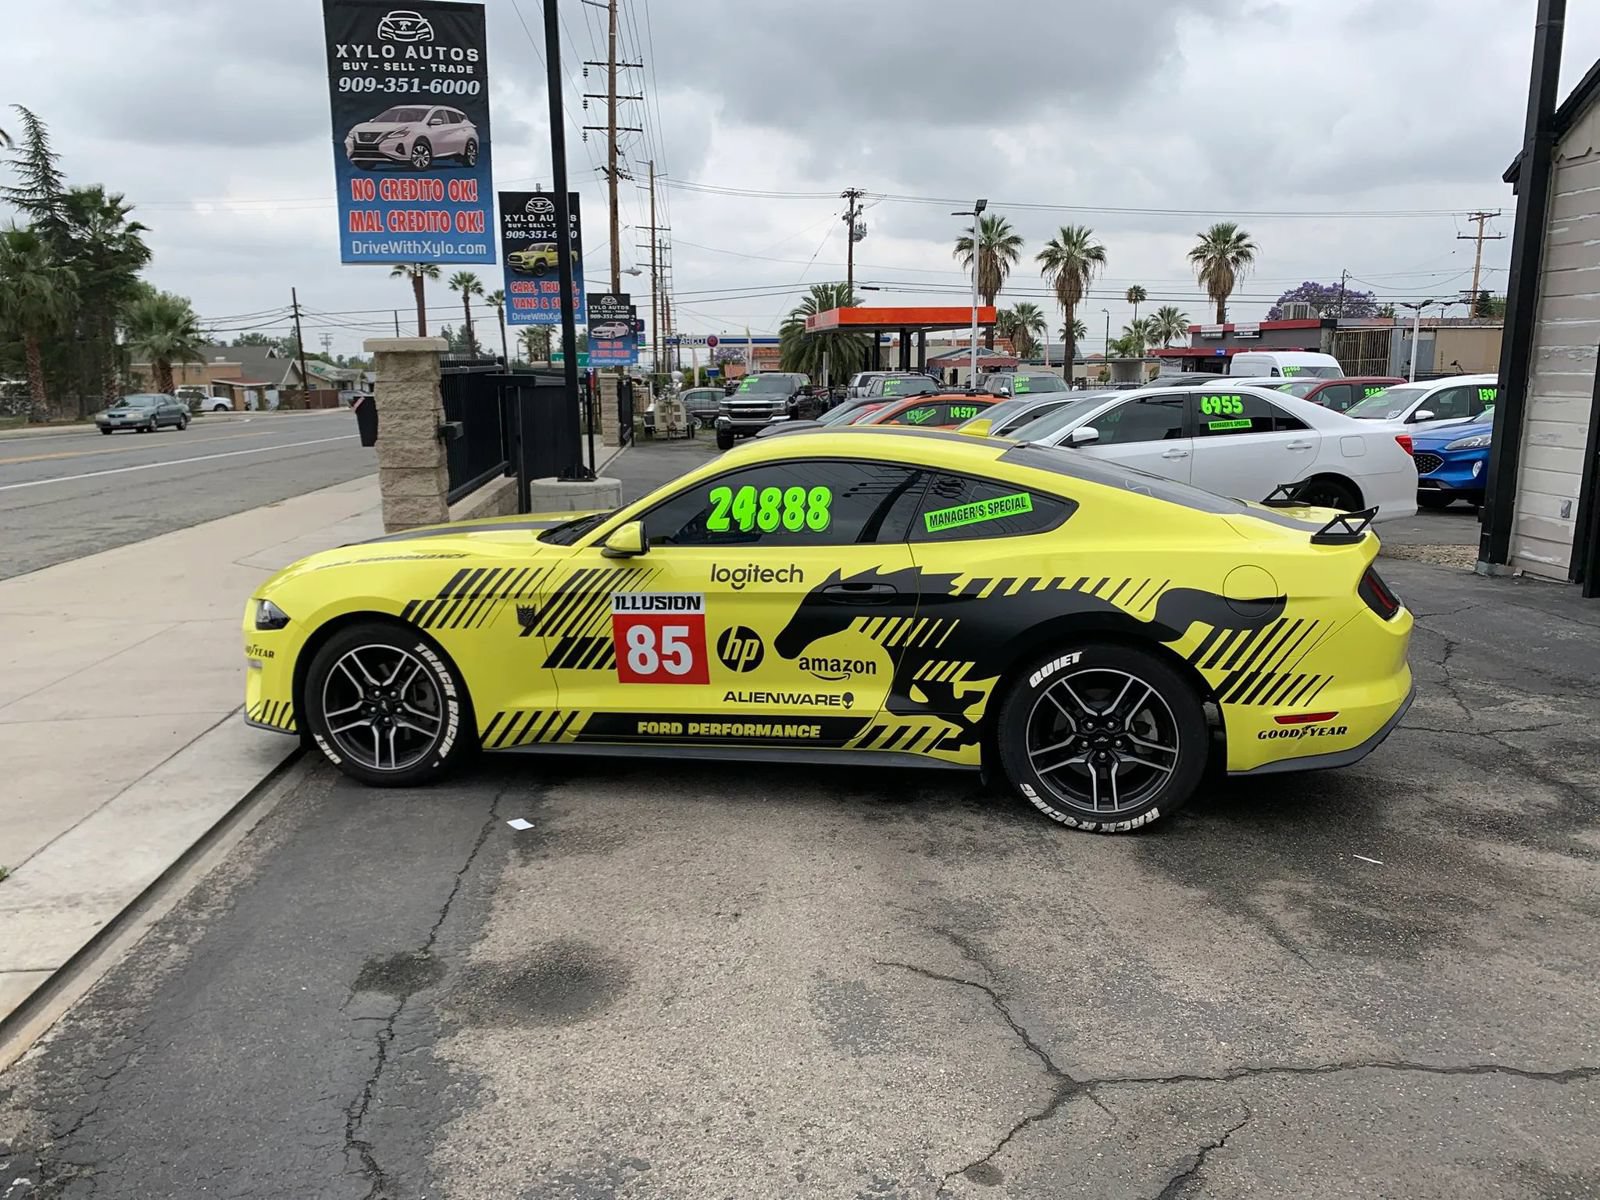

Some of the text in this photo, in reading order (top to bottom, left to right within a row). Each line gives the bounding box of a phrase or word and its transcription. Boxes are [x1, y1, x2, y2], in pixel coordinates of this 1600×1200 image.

[335, 44, 479, 62] XYLO AUTOS
[342, 62, 369, 71] BUY
[383, 62, 415, 72] SELL
[430, 63, 474, 74] TRADE
[338, 77, 480, 95] 909-351-6000
[351, 178, 478, 202] NO CREDITO OK!
[349, 210, 485, 233] MAL CREDITO OK!
[504, 214, 577, 222] XYLO AUS
[506, 230, 578, 239] 909-351-60
[352, 240, 487, 257] DriveWithXylo.com
[511, 281, 539, 295] CARS,
[513, 297, 539, 309] VANS
[541, 297, 549, 309] &
[950, 406, 978, 419] 14577
[1200, 395, 1244, 415] 6955
[706, 486, 832, 532] 24888
[928, 496, 1027, 528] MANAGER'S SPECIAL
[710, 563, 804, 590] logitech
[614, 595, 701, 611] ILLUSION
[625, 624, 694, 676] 85
[722, 626, 759, 672] hp
[414, 642, 457, 698] TRACK
[798, 656, 877, 675] amazon
[1029, 651, 1082, 688] QUIET
[723, 691, 841, 706] ALIENWARE
[637, 721, 821, 738] FORD PERFORMANCE
